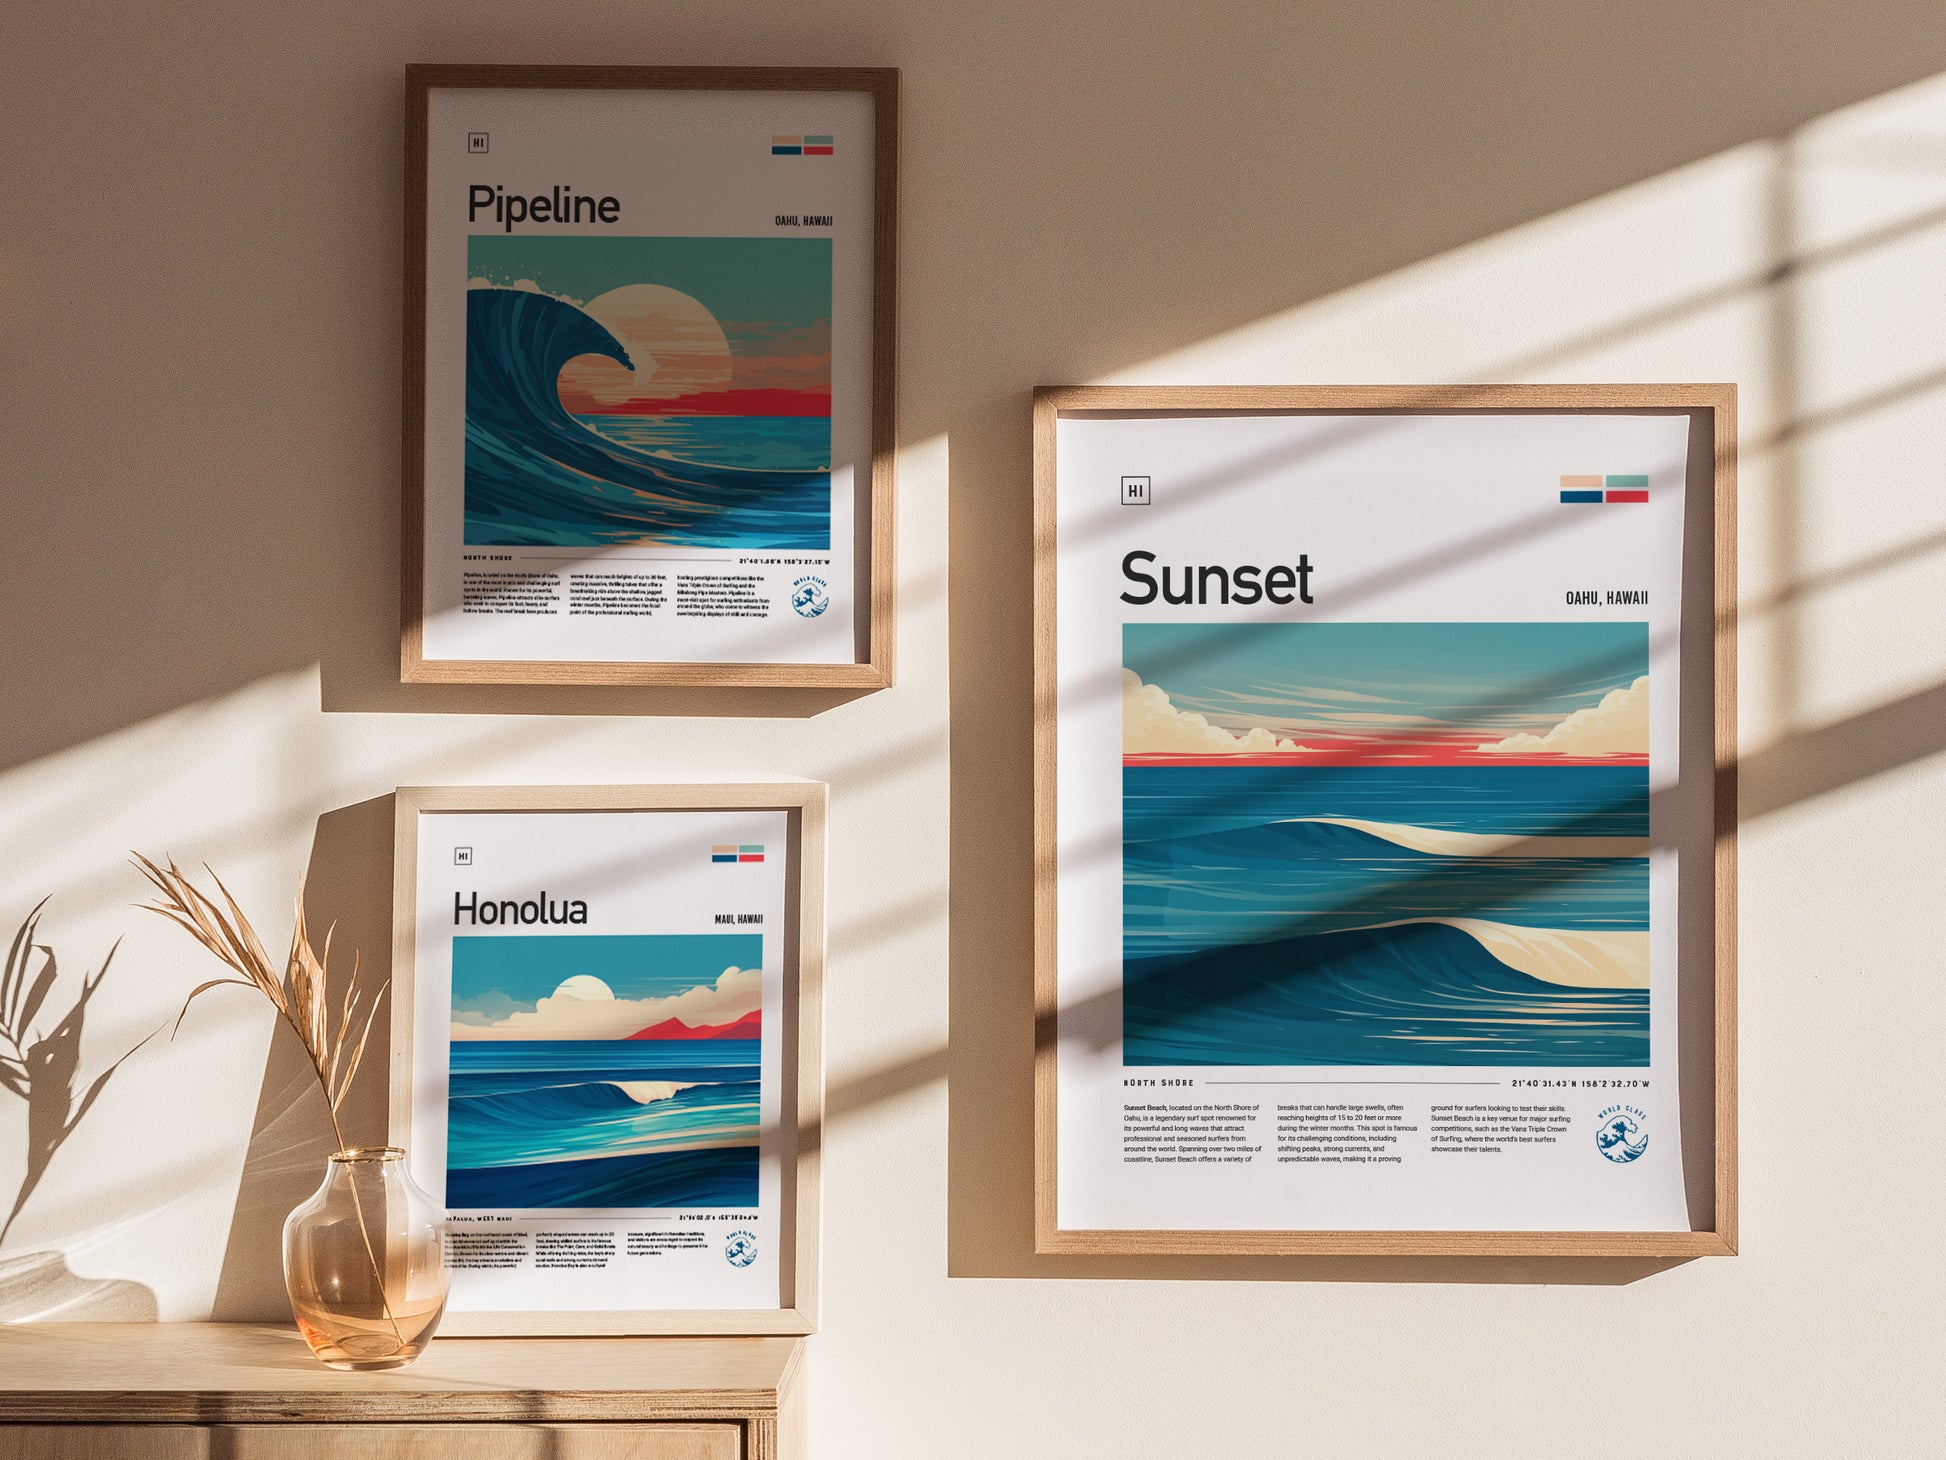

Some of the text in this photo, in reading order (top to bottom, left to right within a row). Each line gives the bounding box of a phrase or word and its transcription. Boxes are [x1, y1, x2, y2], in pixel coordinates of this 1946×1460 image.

[473, 138, 484, 147] HI
[469, 185, 620, 232] Pipeline
[775, 216, 832, 226] OAHU, HAWAII
[1129, 485, 1142, 497] HI
[1120, 550, 1314, 605] Sunset
[1566, 591, 1648, 606] OAHU, HAWAII
[454, 891, 587, 925] Honolua
[715, 914, 763, 925] MAUI, HAWAII
[1598, 1105, 1646, 1120] WORLD CLASS
